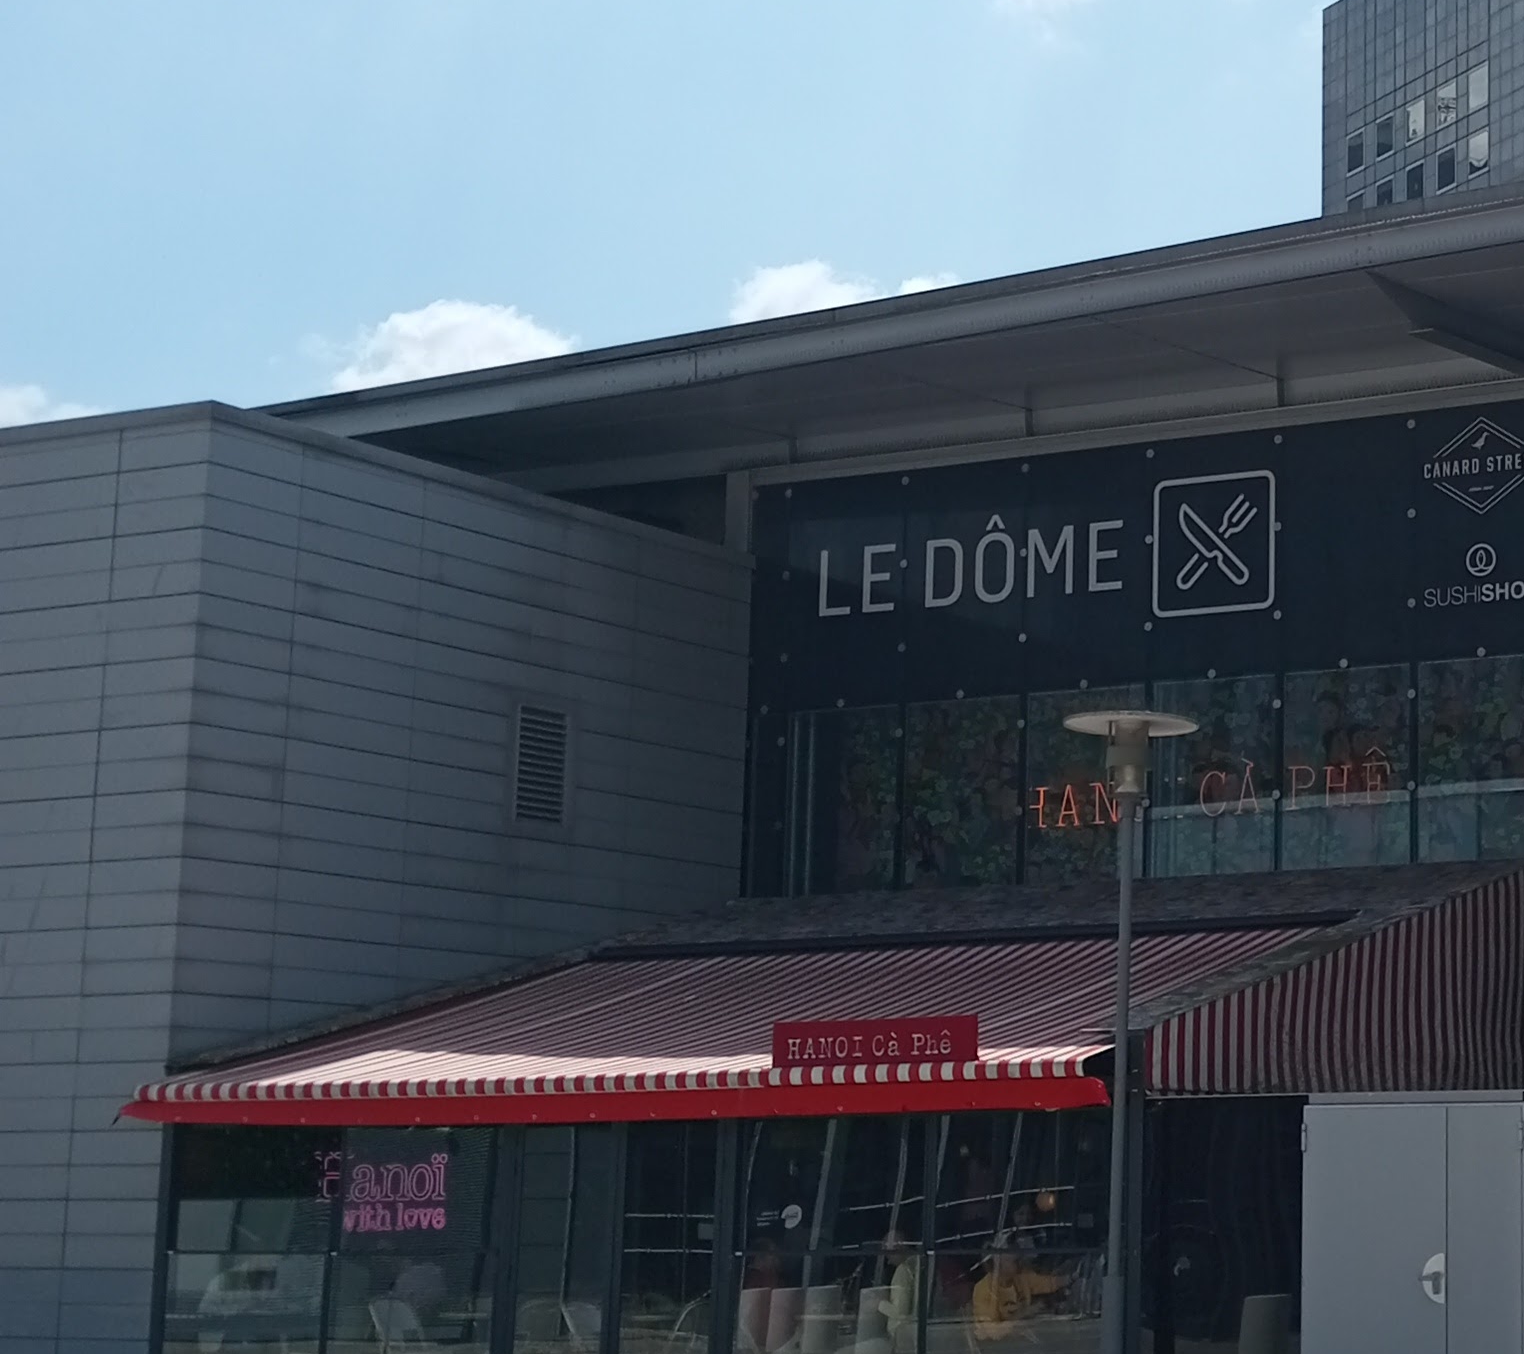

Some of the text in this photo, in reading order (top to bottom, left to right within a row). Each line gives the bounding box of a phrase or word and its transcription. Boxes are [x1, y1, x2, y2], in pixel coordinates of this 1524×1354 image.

[1423, 457, 1480, 479] CANARD
[819, 513, 1125, 617] LE DÔME
[1286, 745, 1391, 810] PHÊ
[787, 1029, 952, 1060] HANOI Cà Phê
[394, 1202, 446, 1231] love
